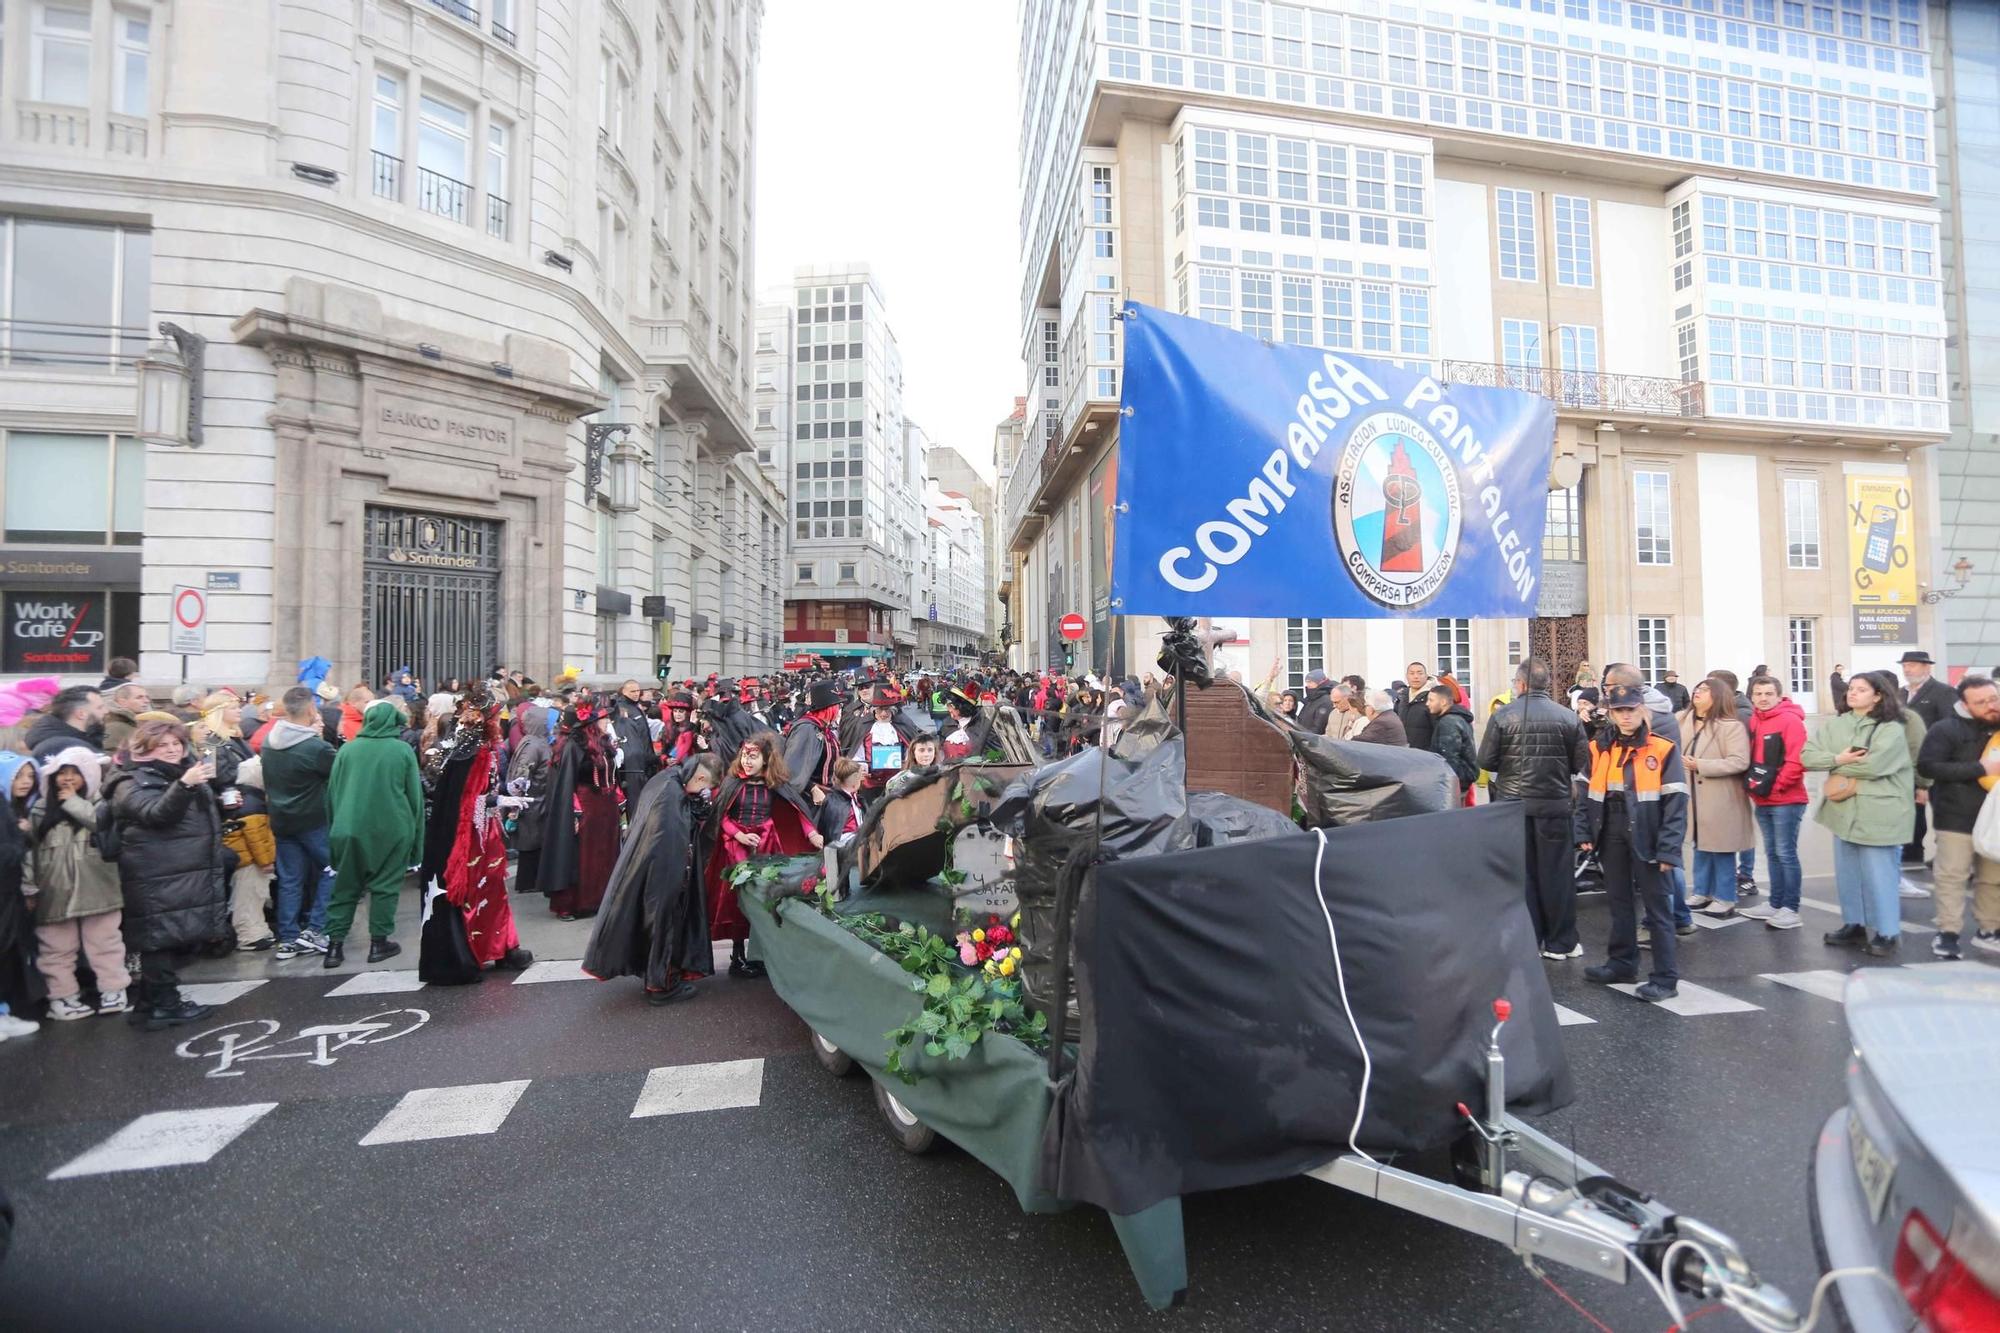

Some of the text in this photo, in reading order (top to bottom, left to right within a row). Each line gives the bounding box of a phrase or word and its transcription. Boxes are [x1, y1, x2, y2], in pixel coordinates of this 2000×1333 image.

[382, 407, 509, 445] BANCO PASTOR
[1158, 353, 1536, 603] COMPARSA PANTALEÓN
[7, 560, 91, 574] Santander
[408, 551, 477, 569] Santander
[1349, 550, 1401, 601] COMPARSA
[15, 602, 76, 619] Work
[14, 620, 67, 638] Café
[23, 652, 91, 663] Santander
